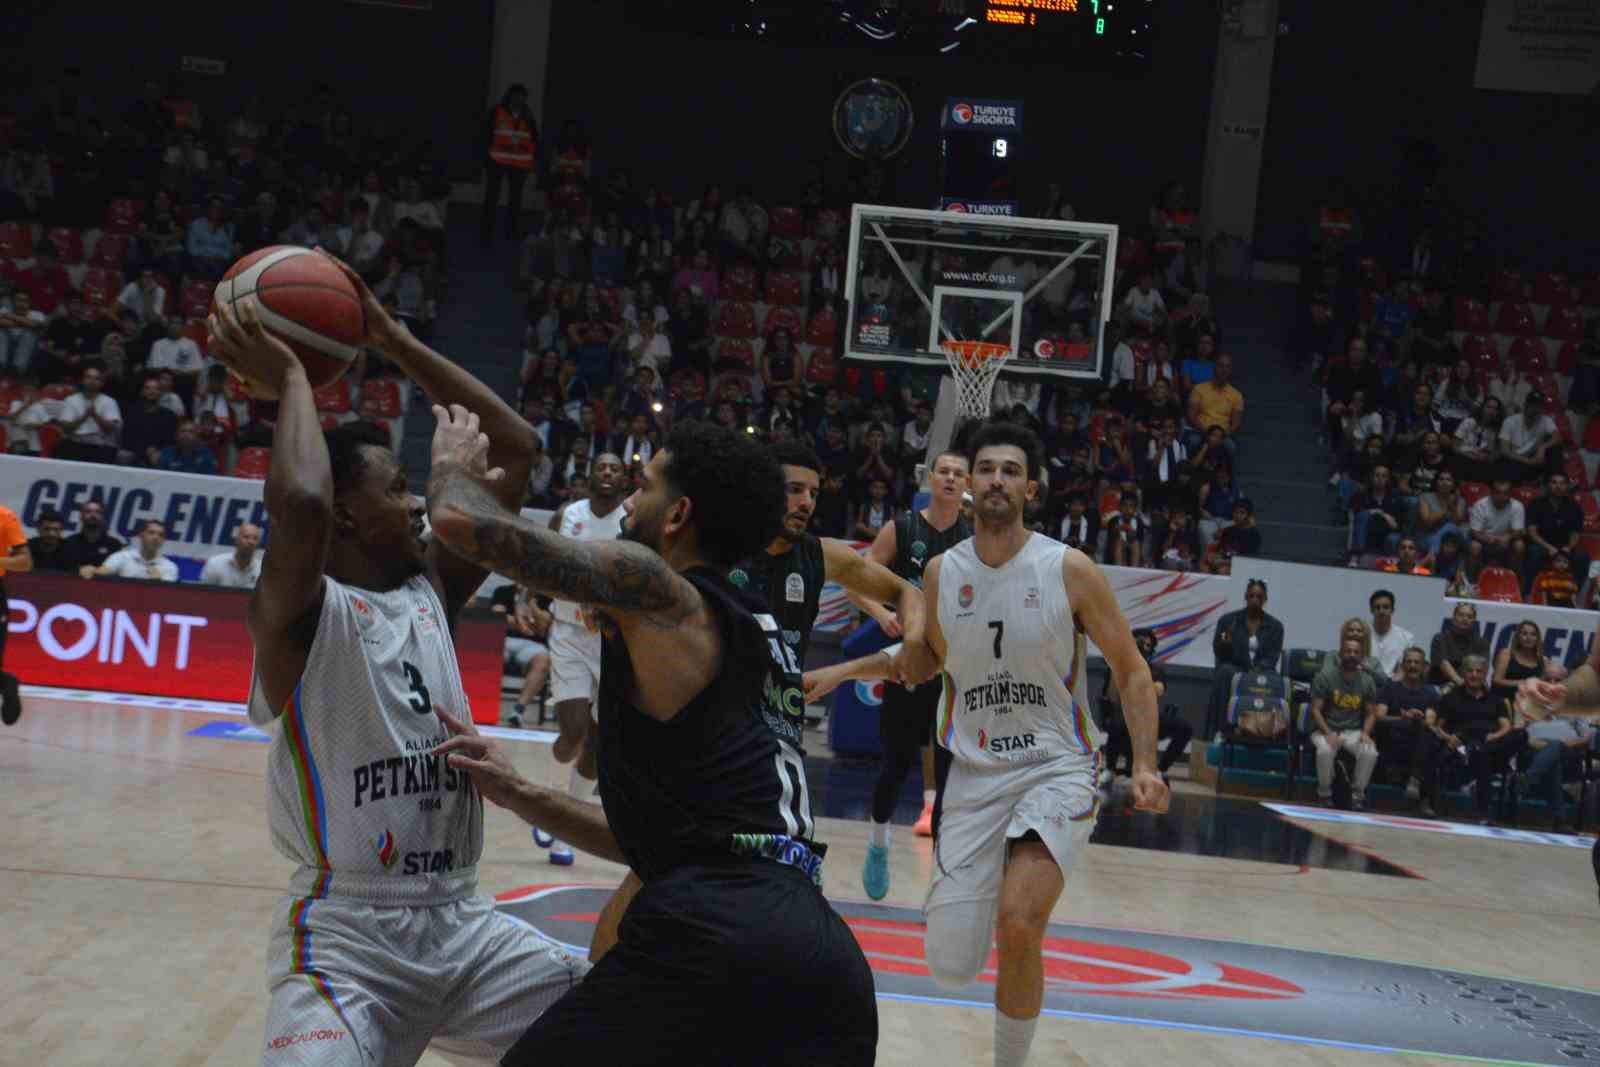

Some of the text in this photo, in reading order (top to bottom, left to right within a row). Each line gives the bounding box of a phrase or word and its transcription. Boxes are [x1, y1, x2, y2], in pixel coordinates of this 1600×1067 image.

[1096, 18, 1105, 34] 8
[988, 620, 1003, 658] 7
[403, 661, 432, 714] 3
[990, 733, 1036, 753] STAR
[403, 850, 454, 875] STAR
